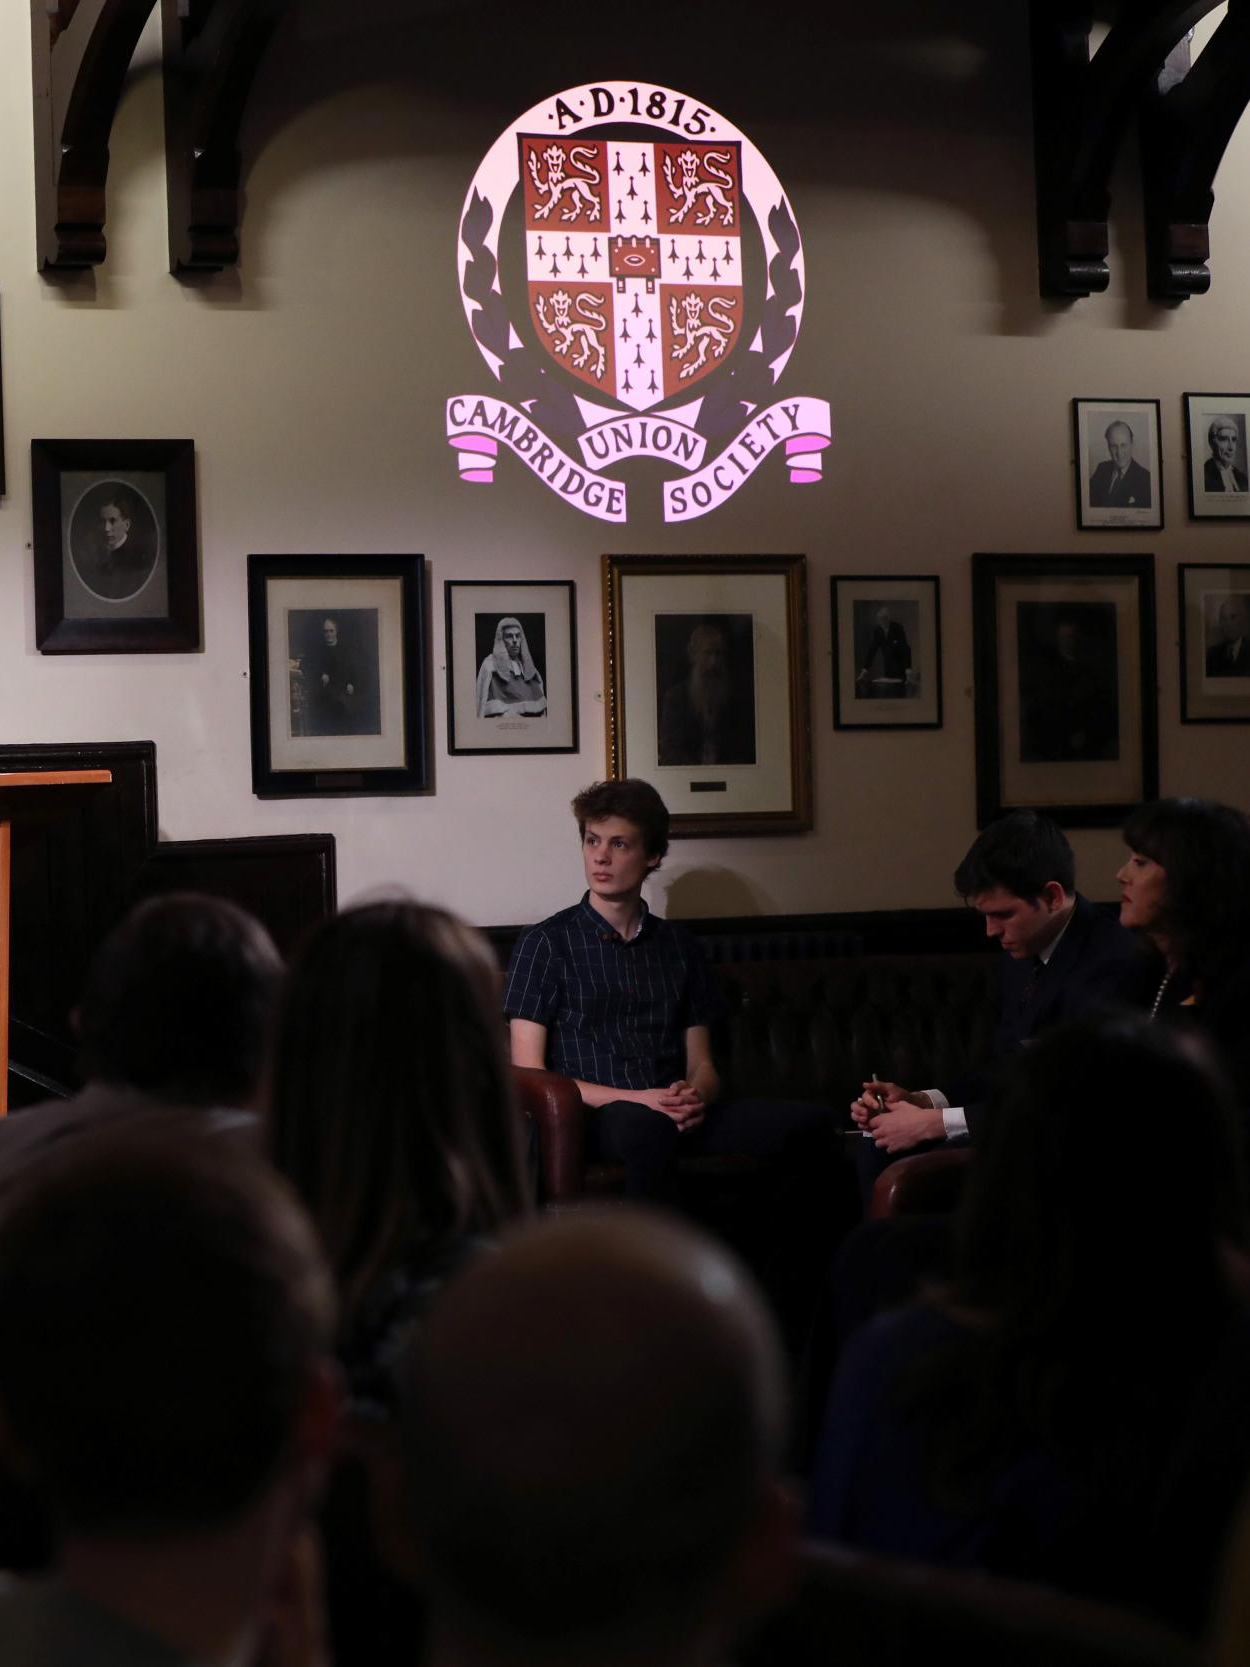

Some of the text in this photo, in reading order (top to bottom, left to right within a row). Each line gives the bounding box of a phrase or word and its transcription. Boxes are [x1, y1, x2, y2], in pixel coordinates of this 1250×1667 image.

[448, 398, 801, 515] CAMBRIDGE UNION SOCIETY
